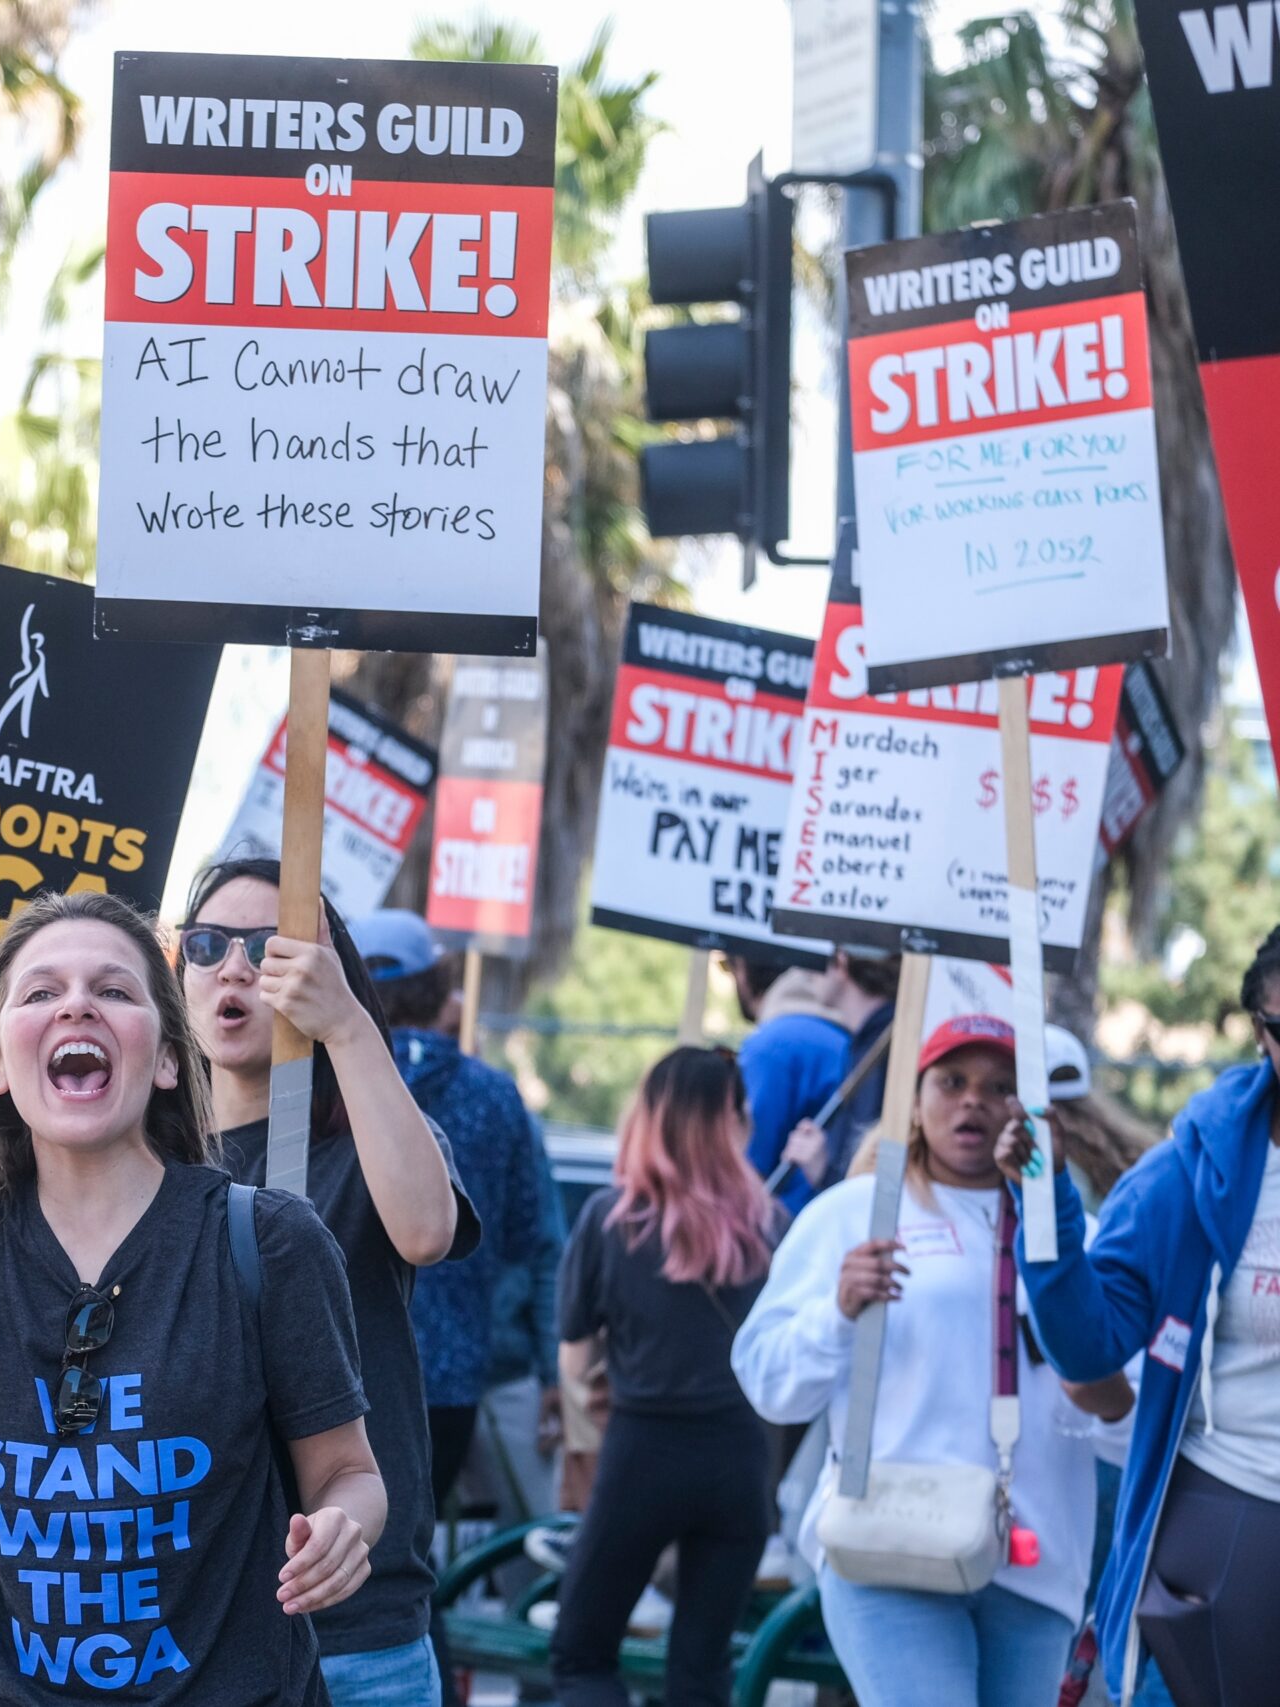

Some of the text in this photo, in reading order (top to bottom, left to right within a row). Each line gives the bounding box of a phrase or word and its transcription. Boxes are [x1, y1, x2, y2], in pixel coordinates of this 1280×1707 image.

[139, 95, 525, 158] WRITERS GUILD
[305, 163, 352, 197] ON
[134, 202, 518, 318] STRIKE!
[863, 236, 1121, 317] WRITERS GUILD
[975, 301, 1009, 332] ON
[136, 336, 209, 387] AI
[397, 348, 520, 404] draw
[868, 314, 1130, 434] STRIKE!
[141, 416, 489, 468] the hands that
[896, 443, 971, 479] FOR
[1081, 433, 1127, 459] YOU
[256, 493, 354, 529] these
[369, 492, 496, 540] stories
[965, 535, 1102, 576] IN 2052
[638, 623, 762, 679] WRITERS
[626, 682, 804, 773] STRIK
[651, 809, 781, 876] PAY ME
[18, 1568, 160, 1624] THE
[12, 1617, 191, 1690] WGA
